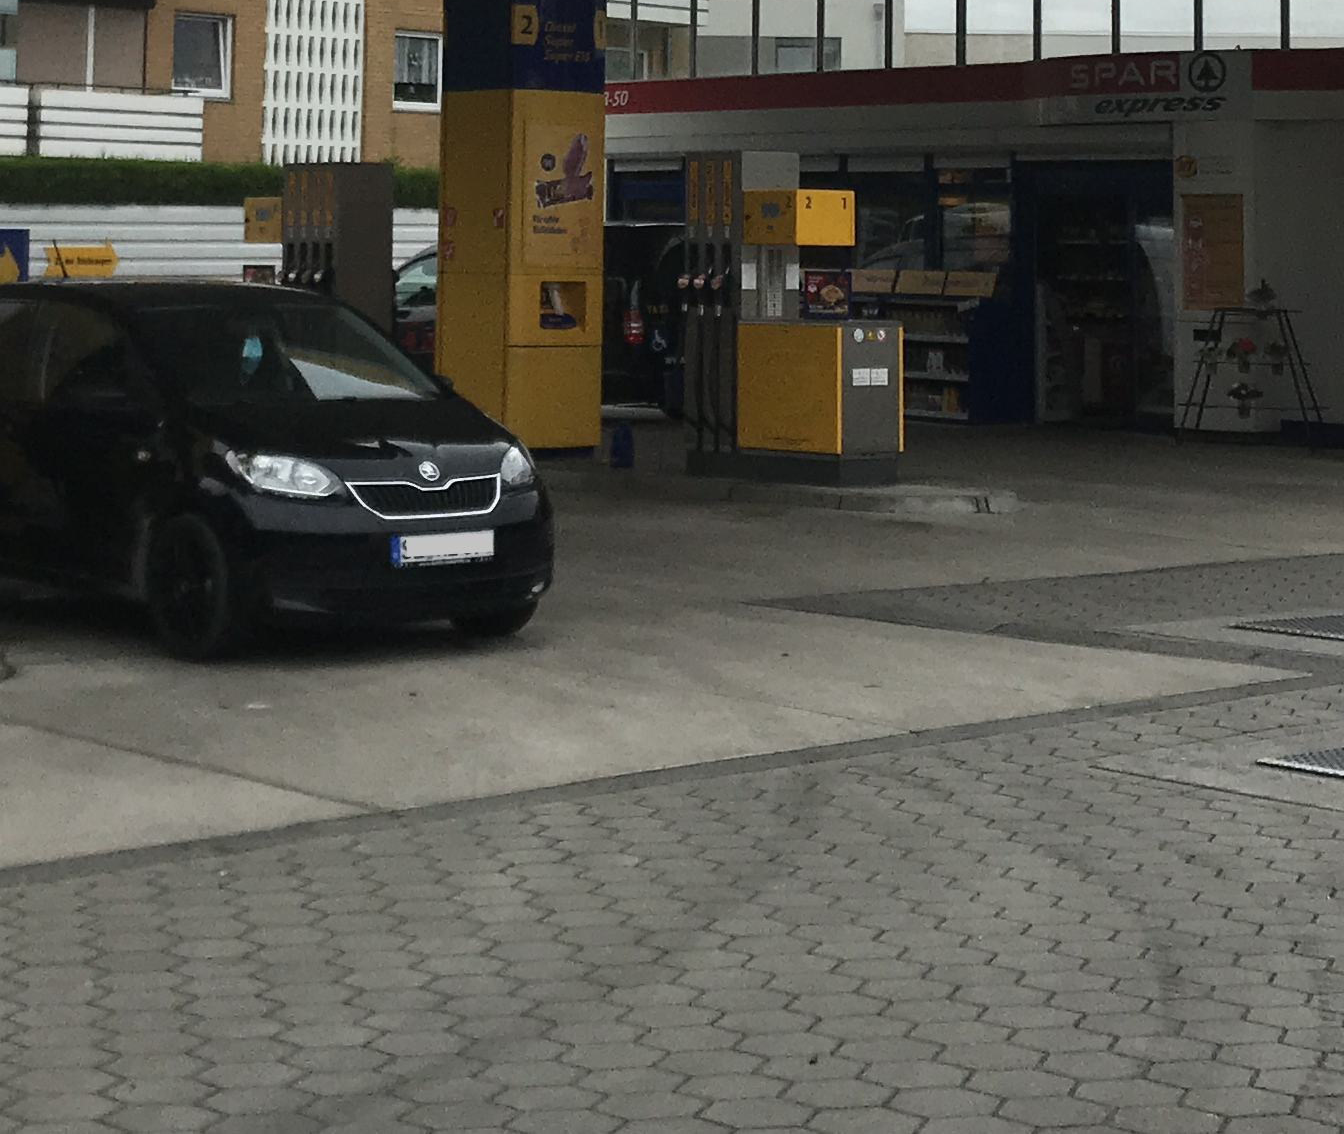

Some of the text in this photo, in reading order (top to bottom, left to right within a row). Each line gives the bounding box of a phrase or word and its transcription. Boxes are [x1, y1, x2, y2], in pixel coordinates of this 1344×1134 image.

[520, 15, 533, 35] 2
[1070, 59, 1179, 89] SPAR
[1094, 93, 1228, 118] express
[805, 196, 848, 210] 2 1
